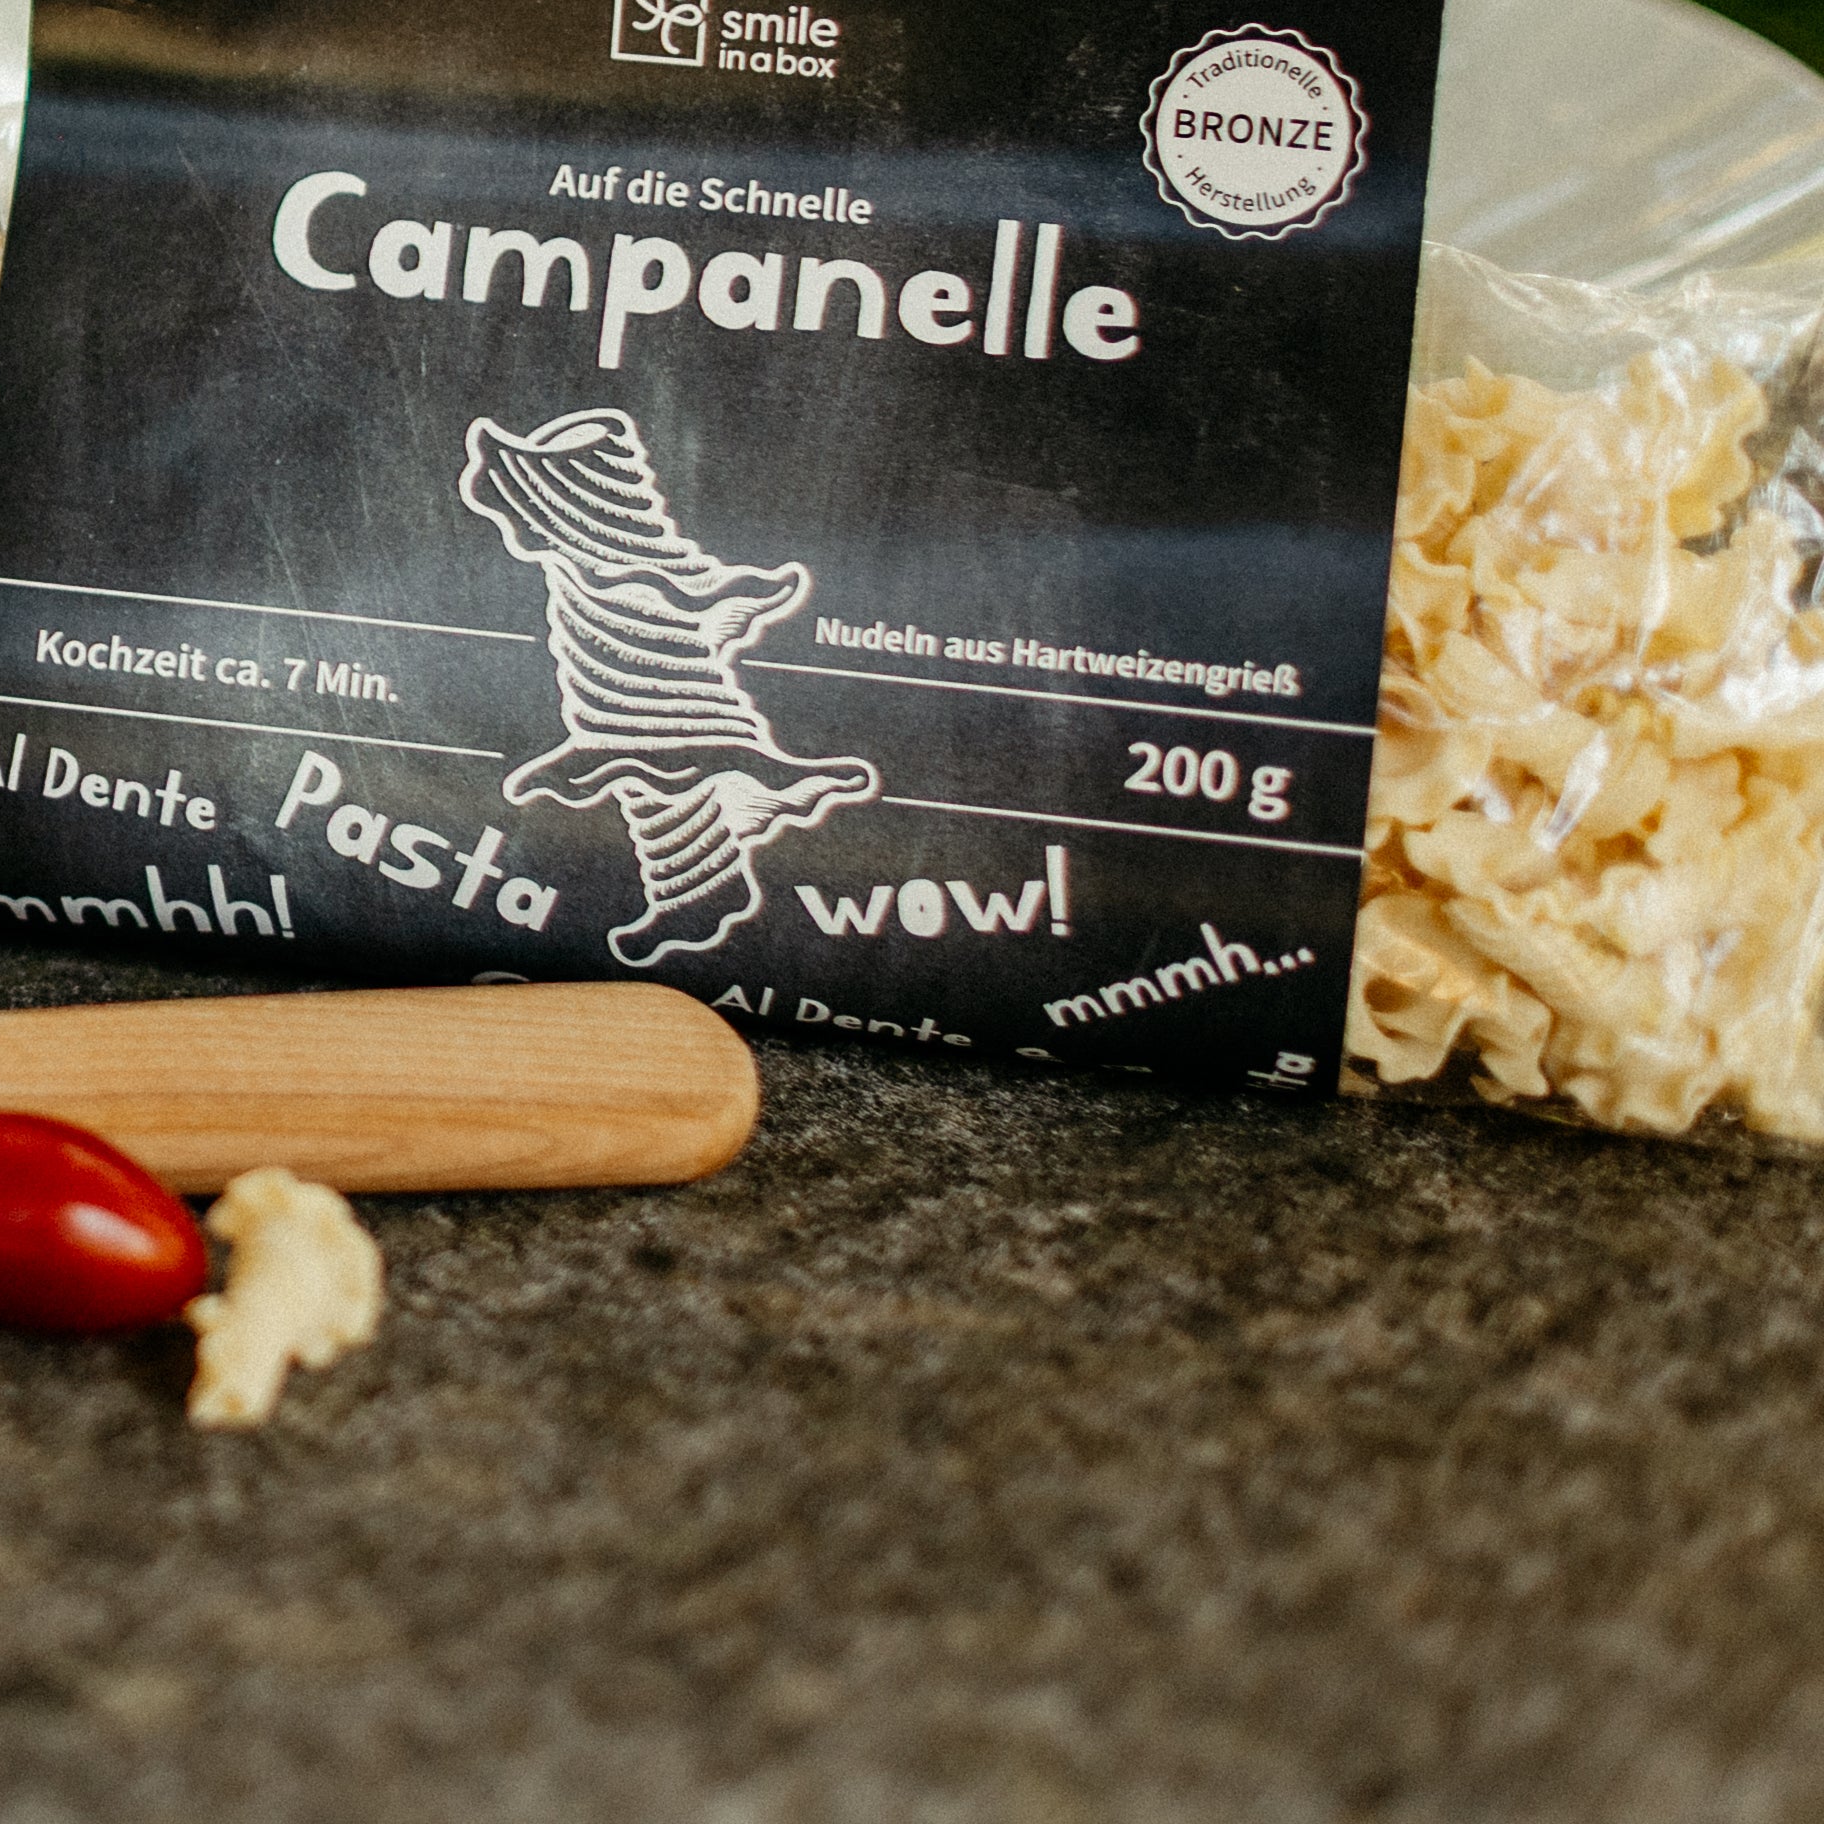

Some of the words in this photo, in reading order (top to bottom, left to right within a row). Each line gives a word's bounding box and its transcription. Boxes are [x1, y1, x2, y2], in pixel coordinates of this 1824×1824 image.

[720, 5, 840, 48] smile
[1185, 48, 1323, 99] Traditionelle
[1173, 109, 1334, 152] BRONZE
[548, 164, 623, 201] Auf
[626, 169, 691, 208] die
[698, 177, 873, 225] Schnelle
[1185, 166, 1317, 213] Herstellung
[271, 171, 1141, 370] Campanelle
[35, 629, 207, 682] Kochzeit
[214, 655, 271, 689] ca.
[282, 658, 307, 691] 7
[315, 660, 399, 703] Min.
[814, 616, 939, 656] Nudeln
[942, 632, 1007, 664] aus
[1011, 637, 1302, 698] Hartweizengrieß
[42, 747, 216, 832] Dente
[1123, 741, 1240, 801] 200
[1247, 762, 1295, 822] g
[274, 749, 559, 933] Pasta
[793, 845, 1071, 937] wow!
[710, 984, 774, 1017] Al
[796, 998, 973, 1049] Dente
